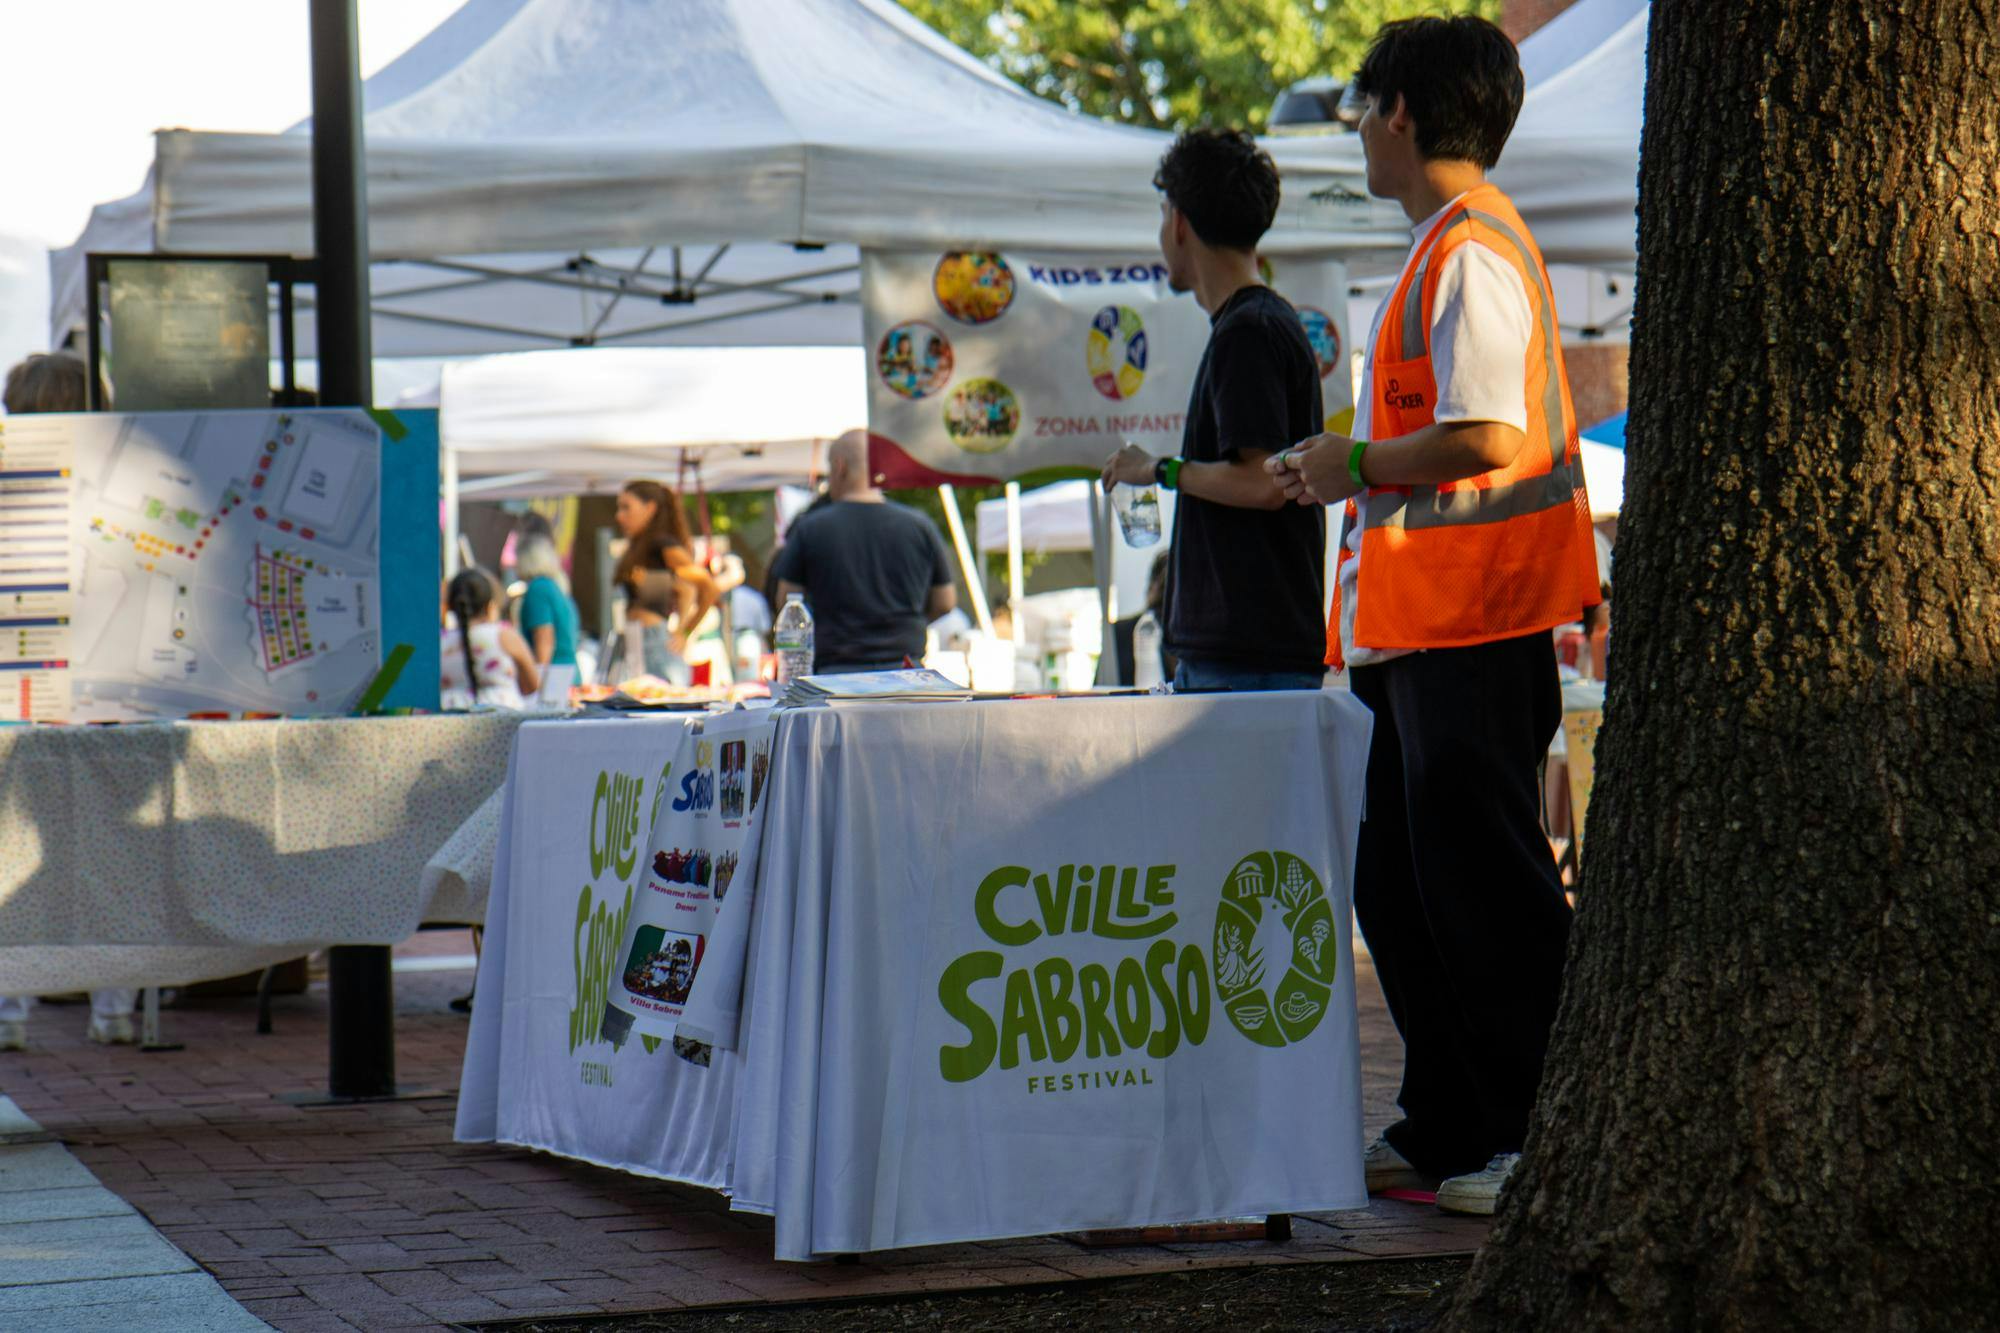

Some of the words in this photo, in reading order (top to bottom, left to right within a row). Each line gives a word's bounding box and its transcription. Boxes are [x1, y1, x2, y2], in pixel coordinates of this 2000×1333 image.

[1029, 265, 1102, 288] KIDS
[1106, 263, 1168, 283] ZON
[1385, 390, 1425, 409] CCKER
[1034, 416, 1099, 437] ZONA
[1107, 412, 1186, 433] INFANT
[648, 881, 686, 898] Panama
[675, 902, 697, 913] Dance
[630, 996, 652, 1009] Villa
[652, 1003, 683, 1016] Sabros
[938, 939, 1211, 1083] SABROSO
[581, 1061, 613, 1088] FESTIVAL
[1028, 1068, 1154, 1094] FESTIVAL
